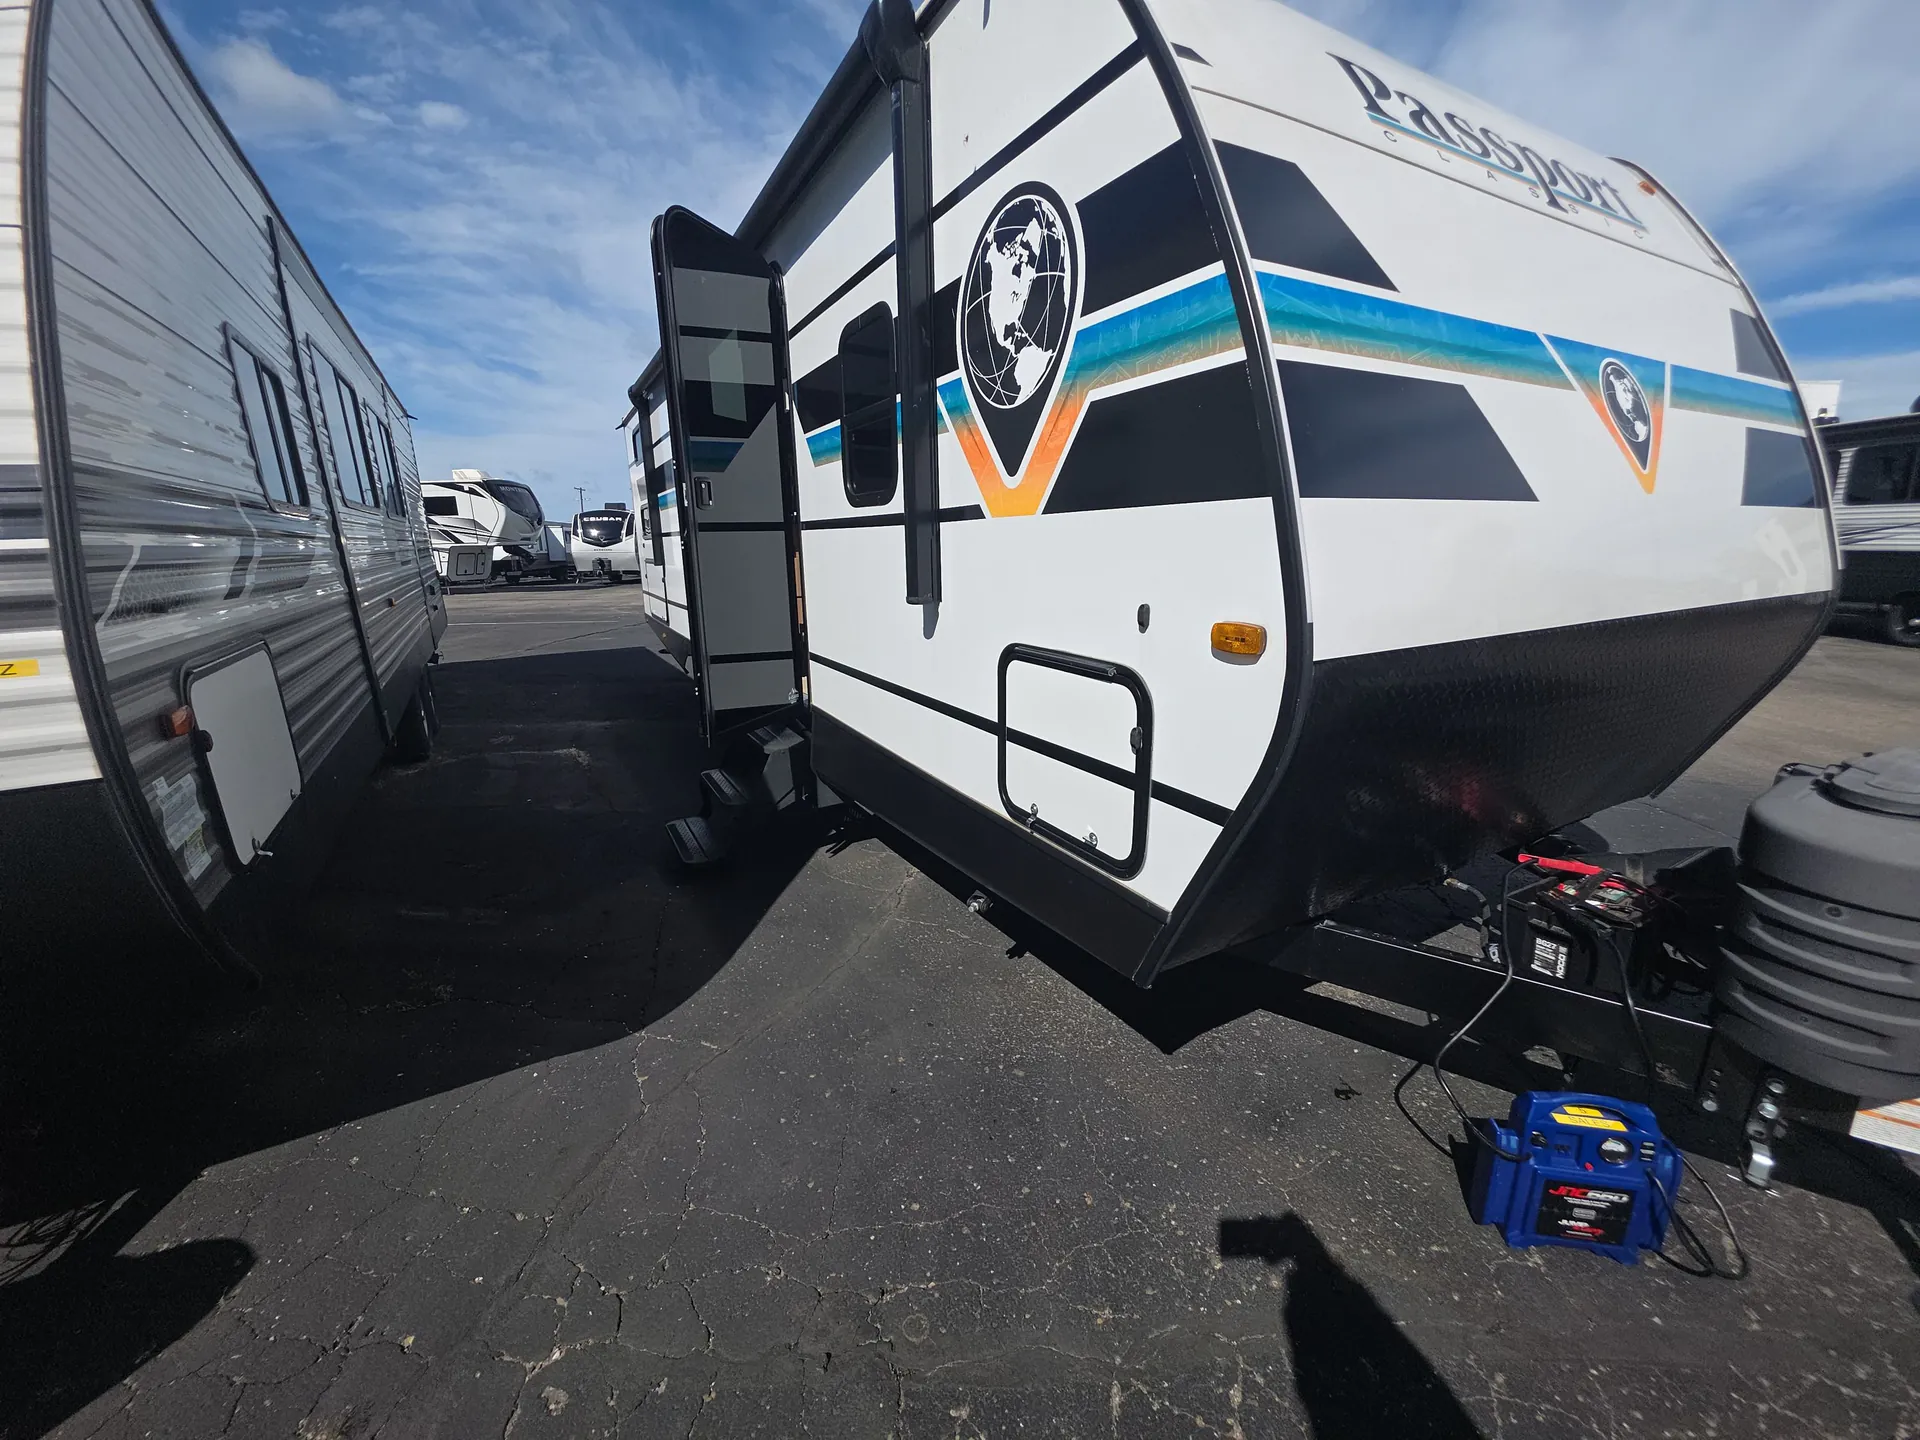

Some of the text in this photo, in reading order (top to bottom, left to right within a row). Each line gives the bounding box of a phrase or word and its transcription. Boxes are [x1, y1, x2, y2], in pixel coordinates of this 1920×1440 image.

[1325, 51, 1643, 225] Passport
[1383, 130, 1645, 239] CLASSIC
[1568, 1116, 1611, 1128] SALES
